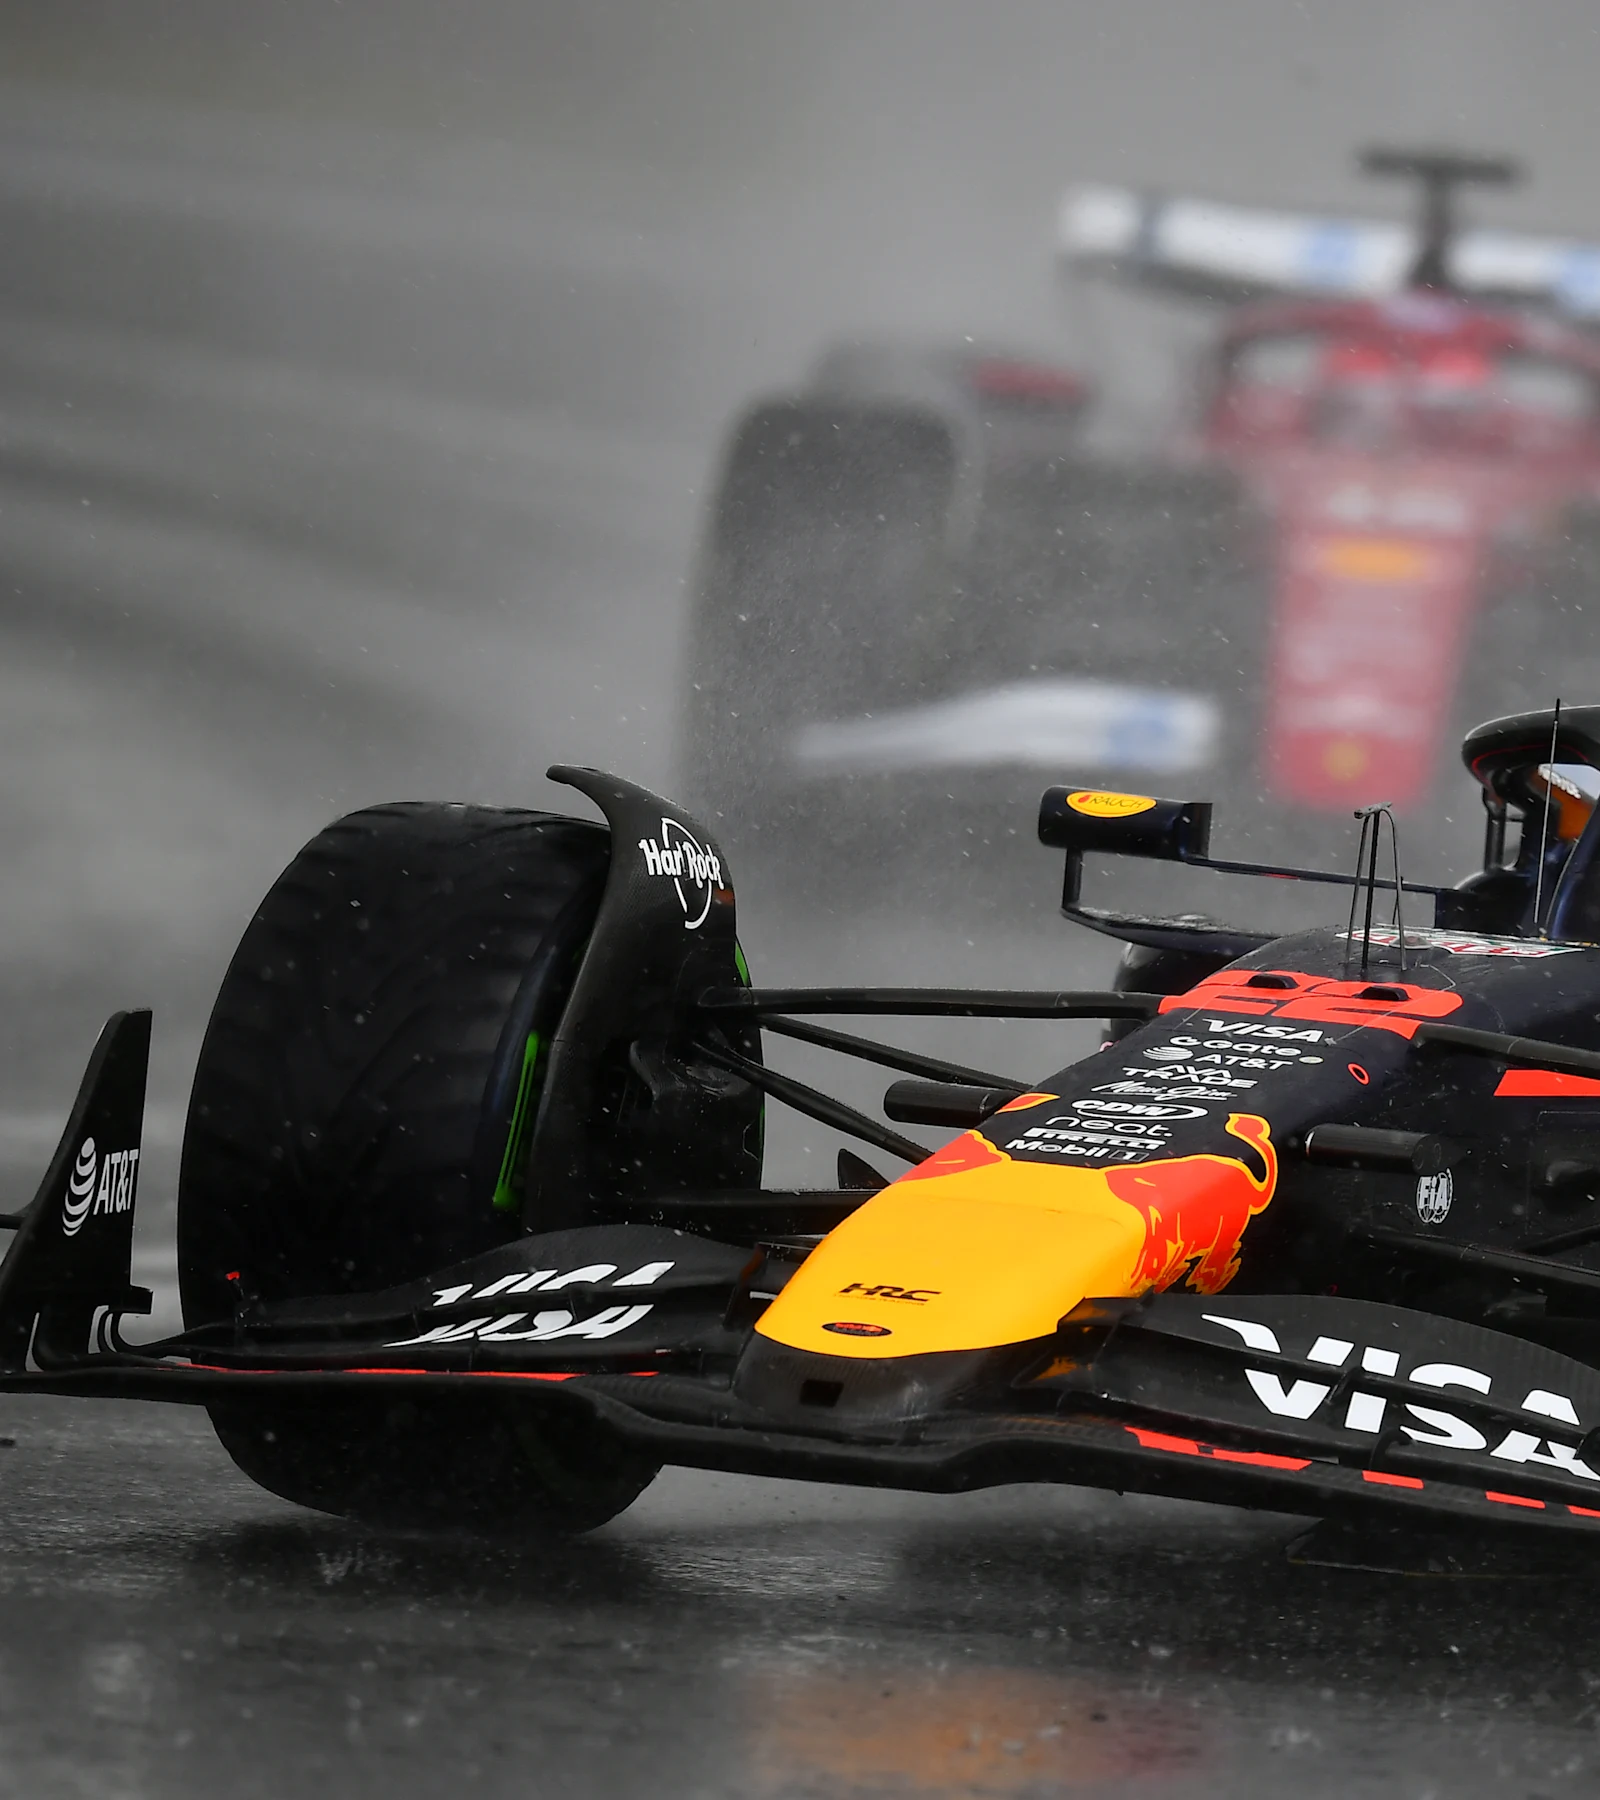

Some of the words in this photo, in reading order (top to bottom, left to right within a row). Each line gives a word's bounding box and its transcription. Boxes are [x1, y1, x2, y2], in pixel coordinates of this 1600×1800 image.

[1089, 797, 1146, 809] RAUCH
[682, 841, 725, 891] Rock
[1202, 1018, 1324, 1043] VISA
[1202, 1039, 1302, 1057] Gate
[1194, 1053, 1294, 1071] AT&T
[1071, 1100, 1178, 1117] CDW
[1045, 1116, 1173, 1138] neat.
[1005, 1139, 1110, 1158] Mobil
[1023, 1127, 1167, 1151] PIRELLI
[93, 1149, 139, 1215] AT&T
[839, 1283, 942, 1302] HRC
